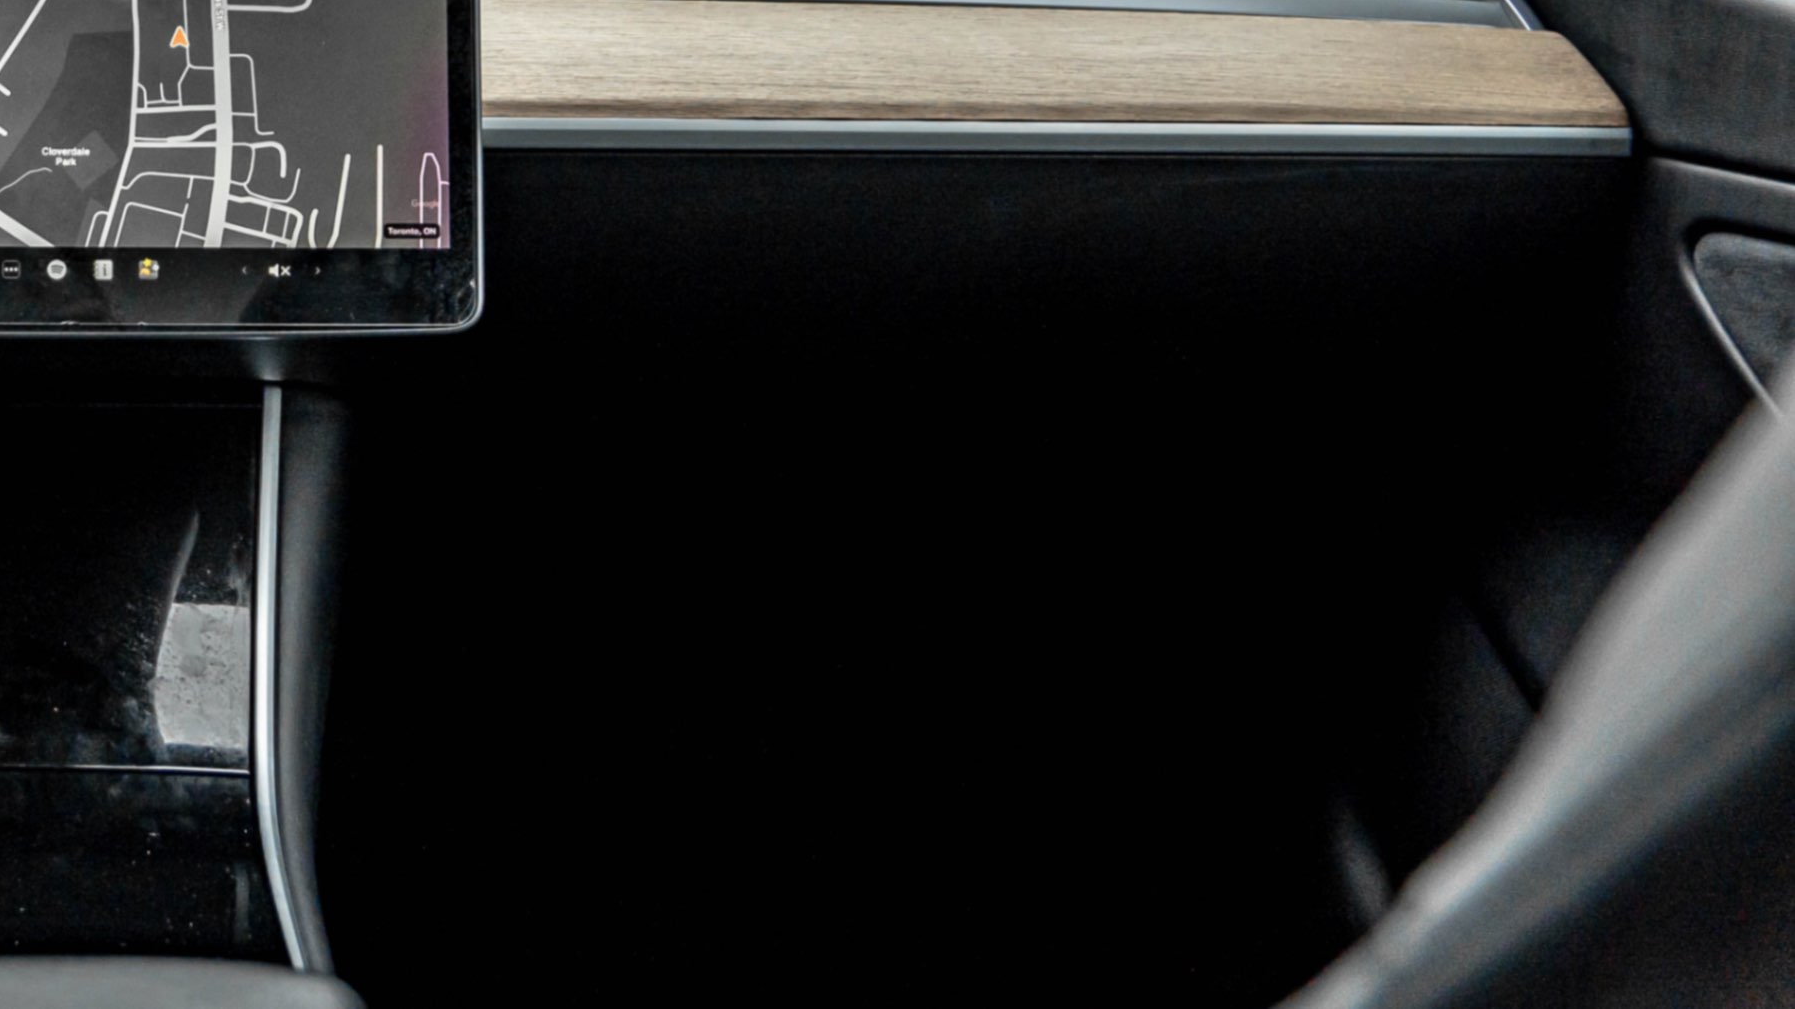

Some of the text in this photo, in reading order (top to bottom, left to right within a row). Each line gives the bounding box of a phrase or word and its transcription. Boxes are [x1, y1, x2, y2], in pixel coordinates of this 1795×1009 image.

[41, 146, 91, 157] Cloverdale
[55, 157, 77, 166] Park
[387, 226, 437, 236] Toronto, ON
